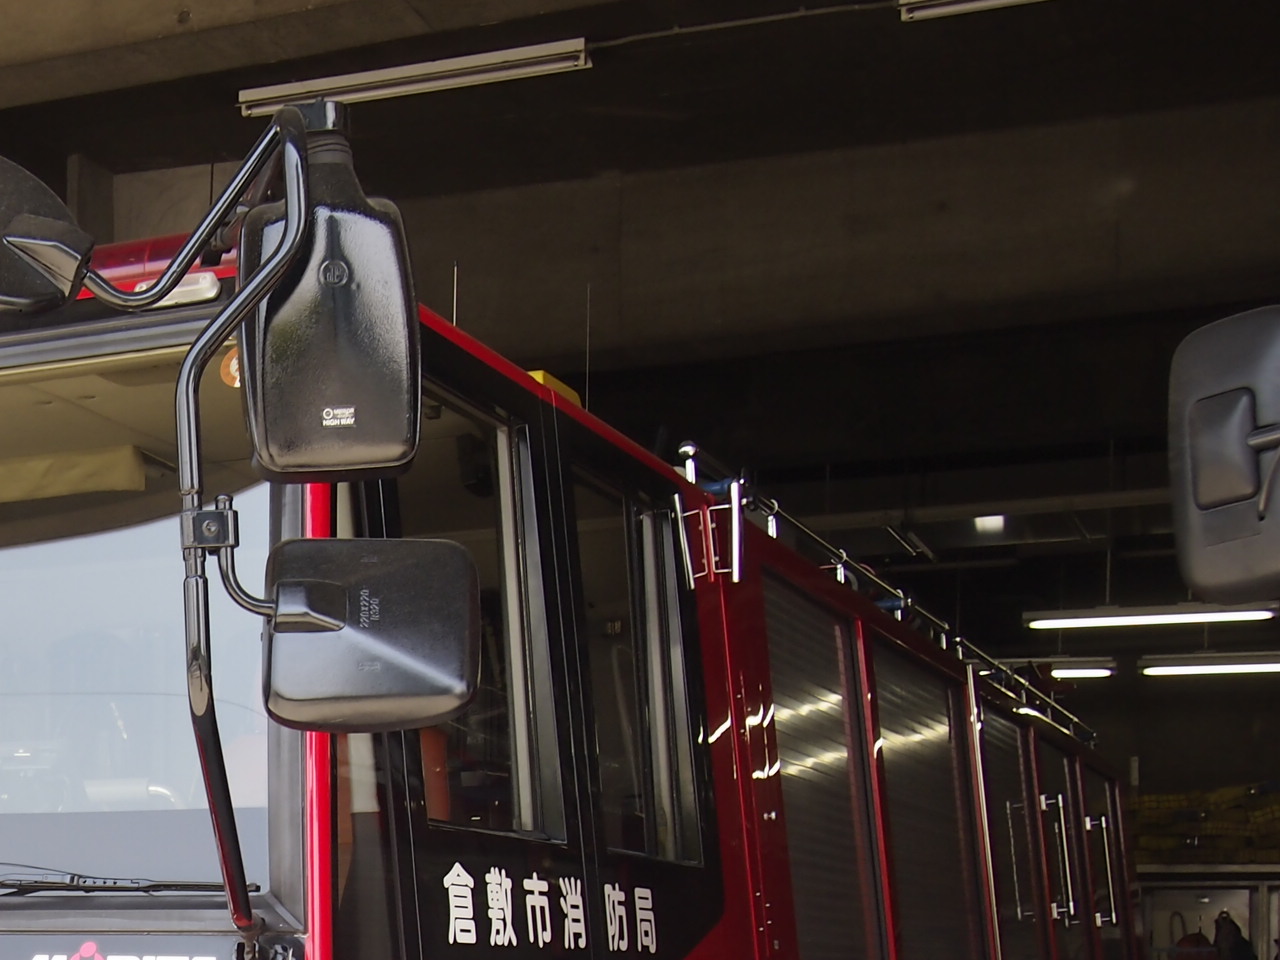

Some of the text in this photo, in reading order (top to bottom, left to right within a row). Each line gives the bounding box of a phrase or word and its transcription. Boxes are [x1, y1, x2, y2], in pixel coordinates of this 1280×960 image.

[443, 862, 657, 954] 倉敷市消防局
